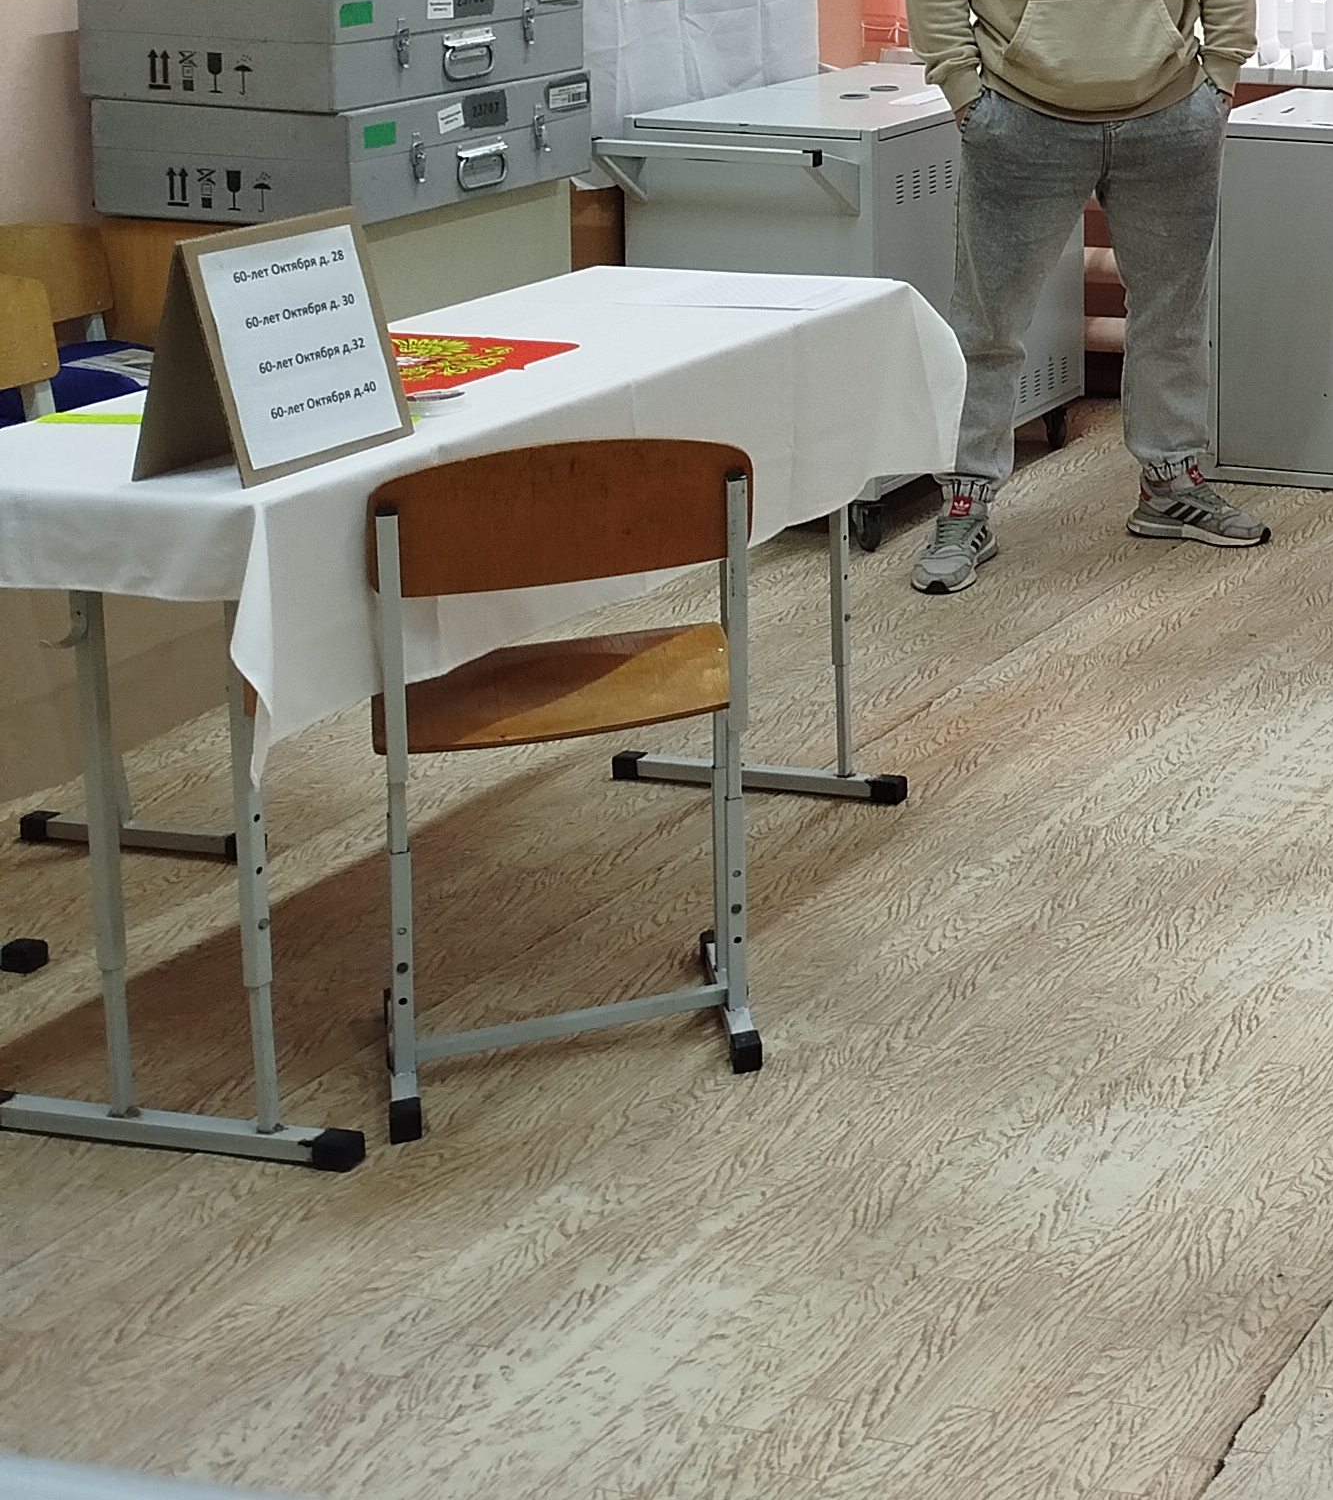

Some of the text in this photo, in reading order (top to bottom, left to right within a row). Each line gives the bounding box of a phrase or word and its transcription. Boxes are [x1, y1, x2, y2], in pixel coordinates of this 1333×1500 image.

[233, 249, 345, 283] 60-лет Октября д. 28
[245, 294, 355, 329] 60-лет Октября д. 30
[259, 357, 294, 374] 60-лет
[296, 346, 340, 365] Октября
[270, 402, 305, 419] 60-лет
[307, 390, 352, 409] Октября
